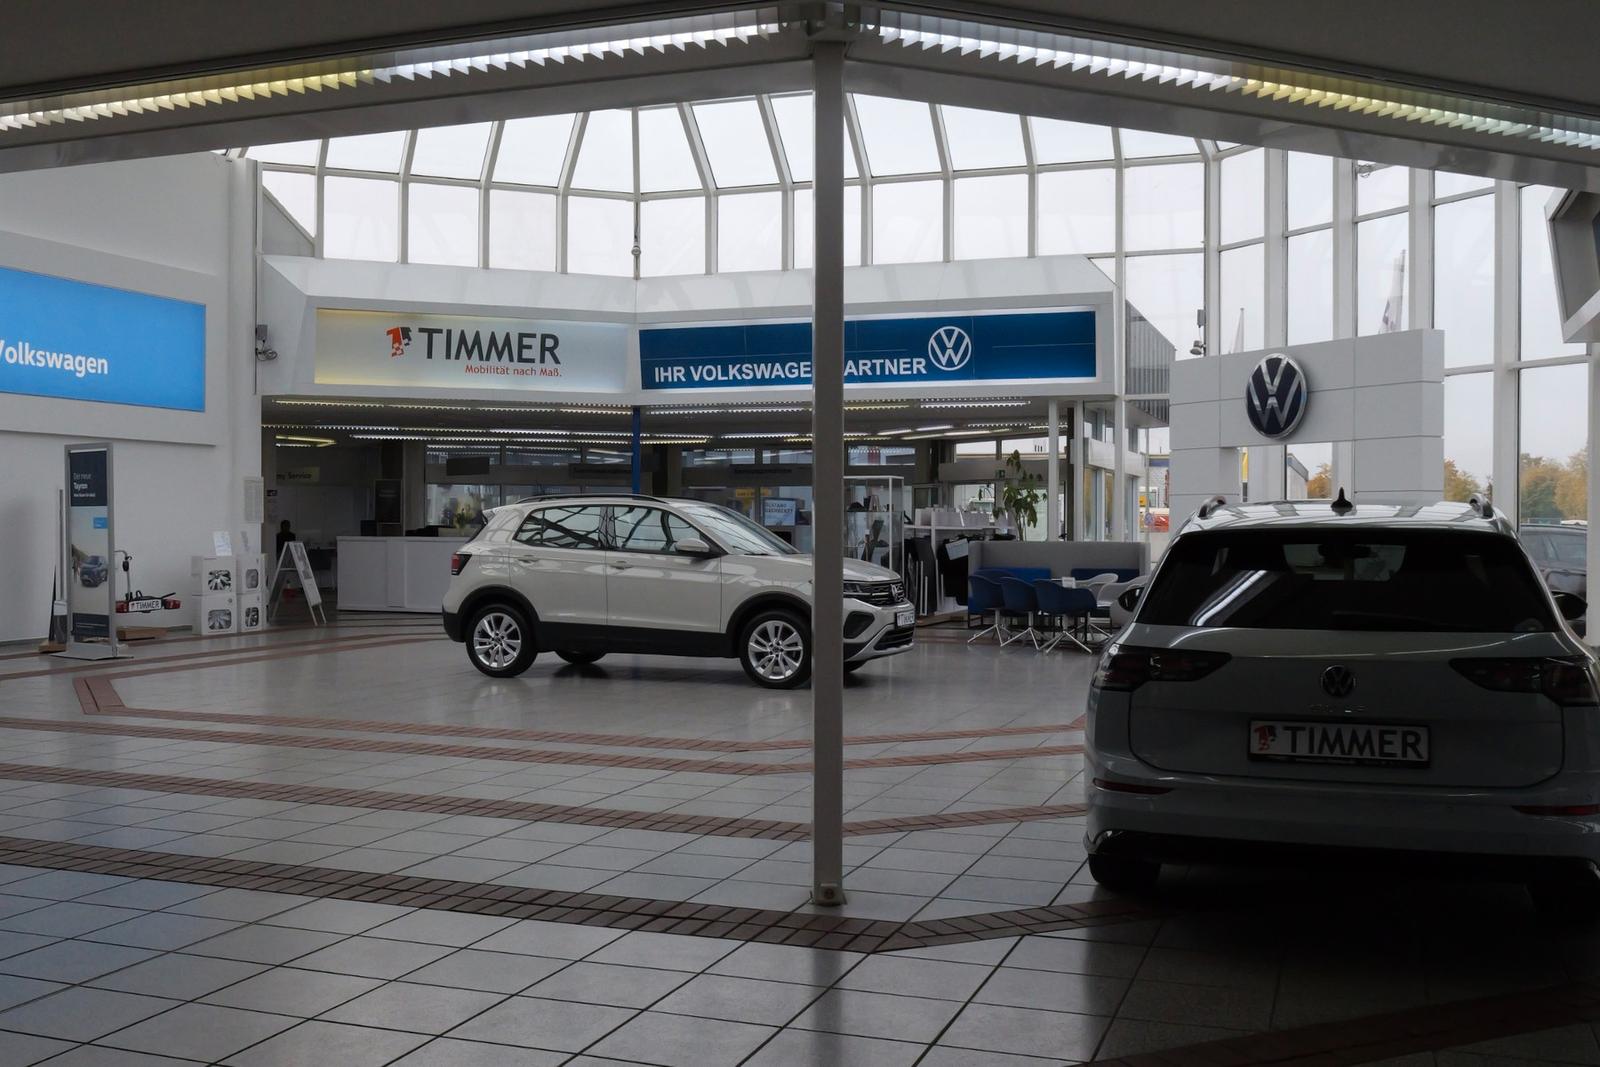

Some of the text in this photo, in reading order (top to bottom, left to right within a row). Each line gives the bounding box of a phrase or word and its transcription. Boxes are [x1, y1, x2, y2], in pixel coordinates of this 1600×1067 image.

[418, 327, 561, 365] TIMMER
[465, 365, 562, 377] Mobilität nach Maß.
[654, 358, 927, 383] IHR VOLKSWAGE ARTNER
[1282, 725, 1424, 760] TIMMER
